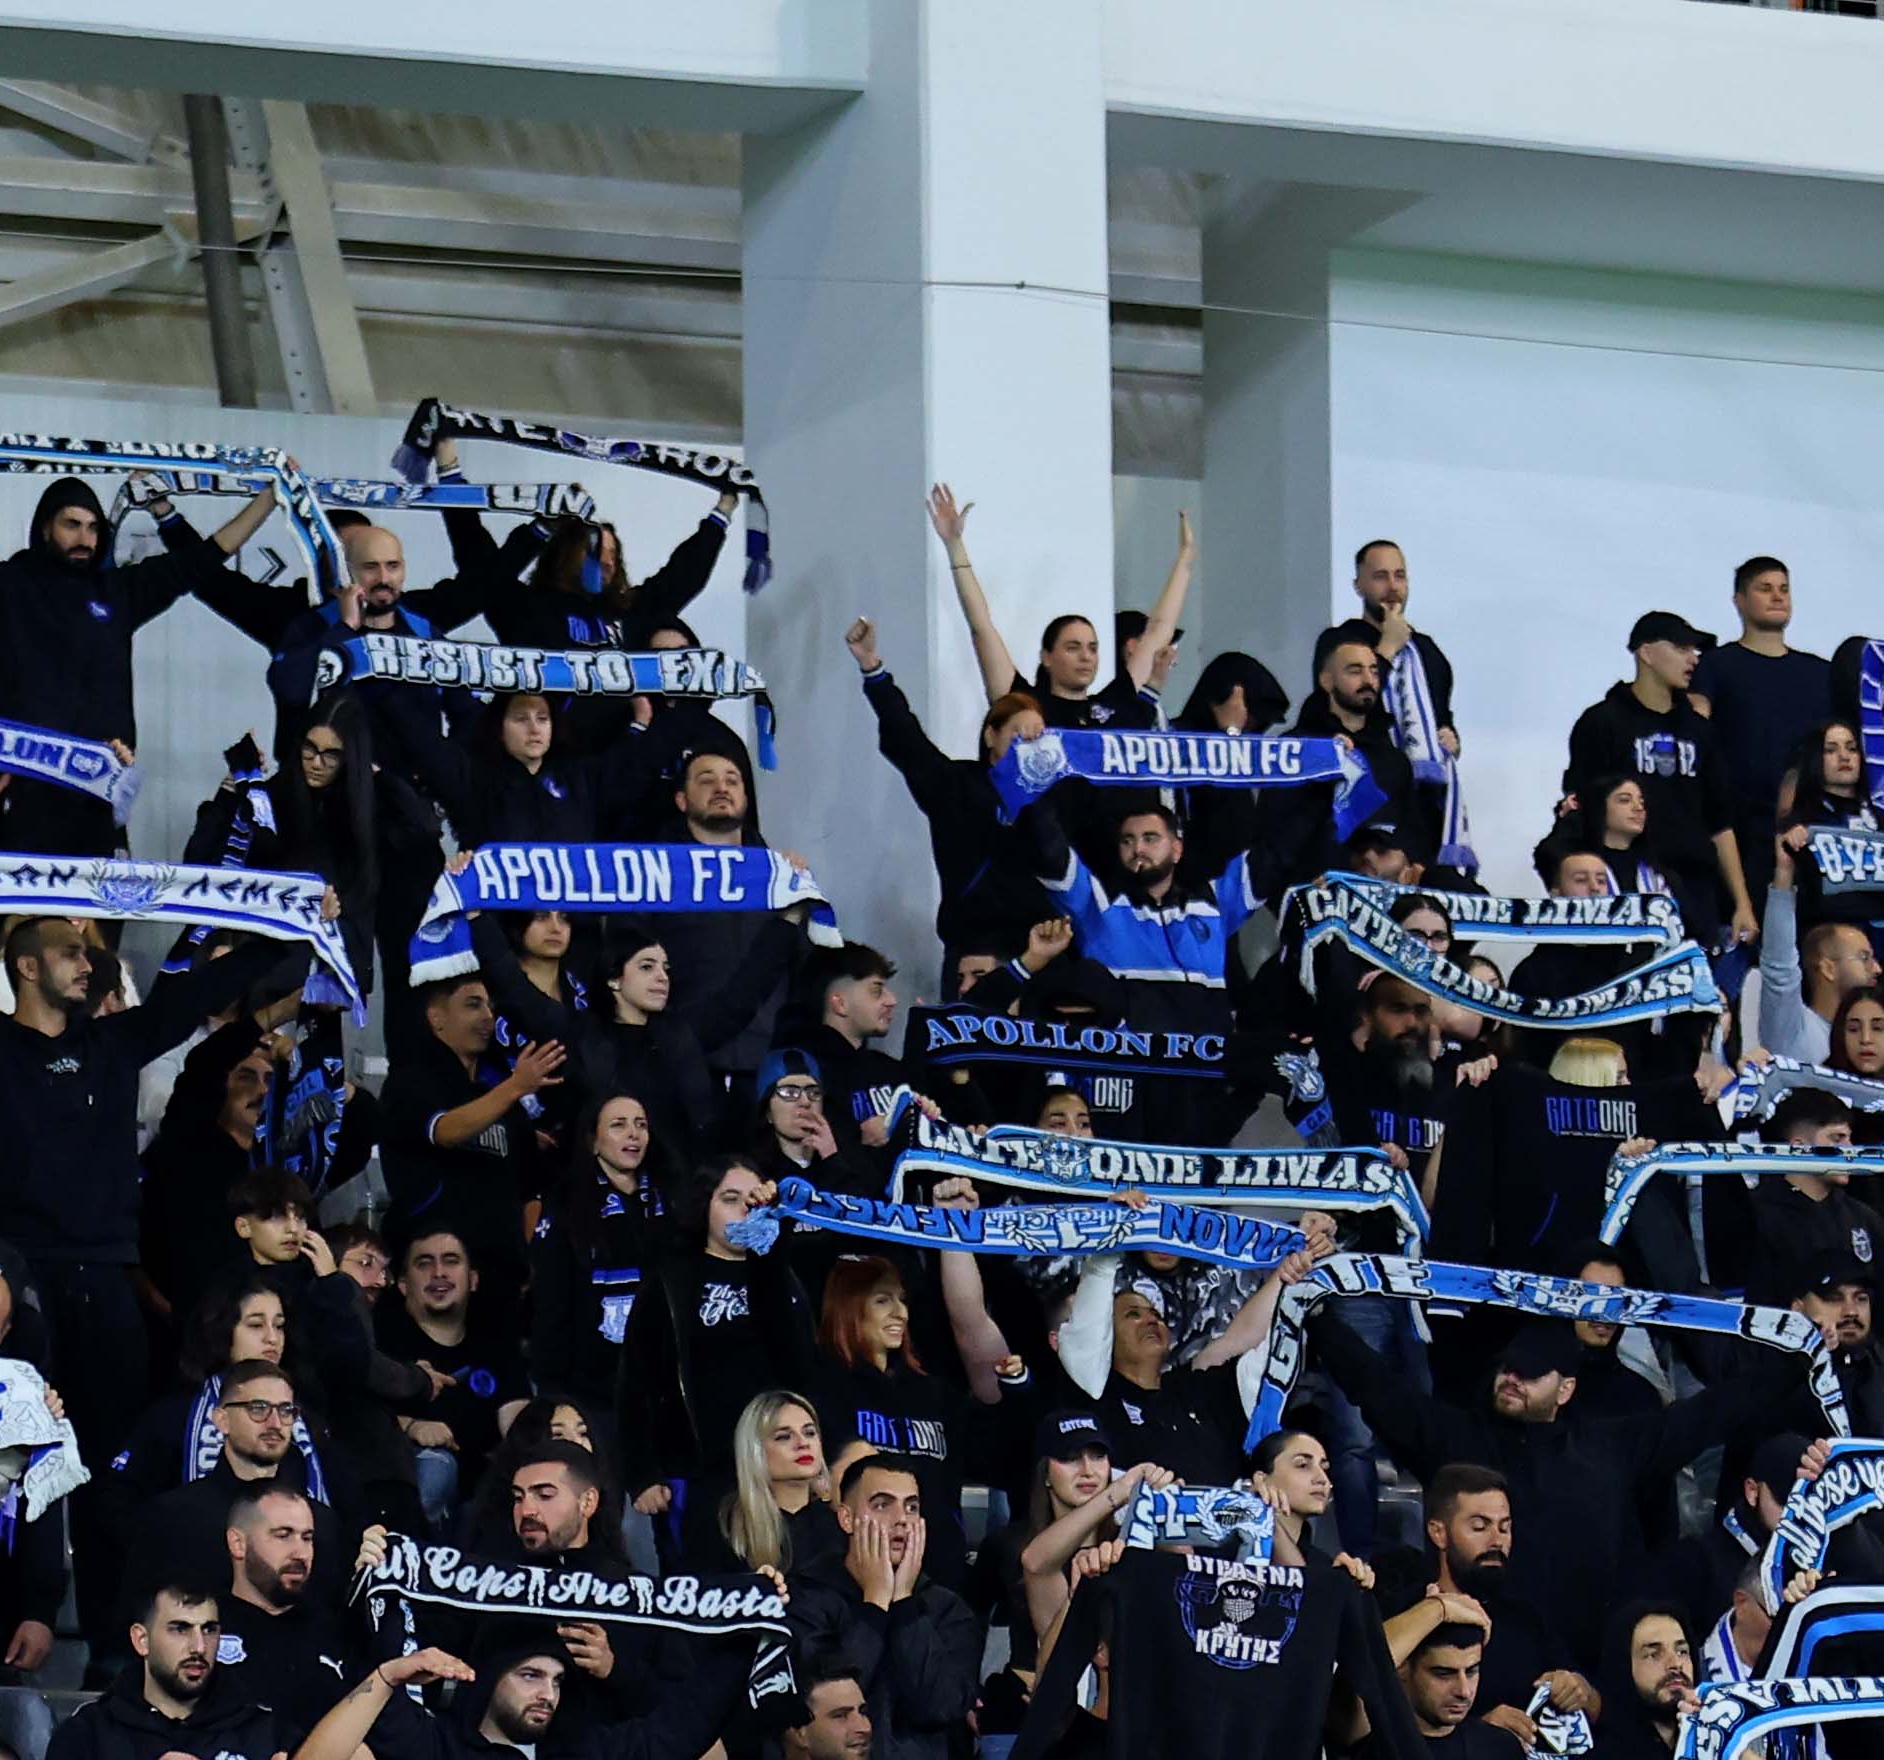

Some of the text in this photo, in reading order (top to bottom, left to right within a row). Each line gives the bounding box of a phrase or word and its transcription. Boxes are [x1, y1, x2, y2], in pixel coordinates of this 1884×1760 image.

[366, 633, 544, 694] RESIST
[565, 651, 633, 695] TO
[1101, 731, 1304, 777] APOLLON FC
[471, 846, 747, 906] APOLLON FC
[925, 1013, 1228, 1066] APOLLON FC
[1088, 1145, 1203, 1187] ONE
[423, 1545, 789, 1621] Cops Are Basta
[1195, 1628, 1283, 1665] ΚΡΗΤΗΣ
